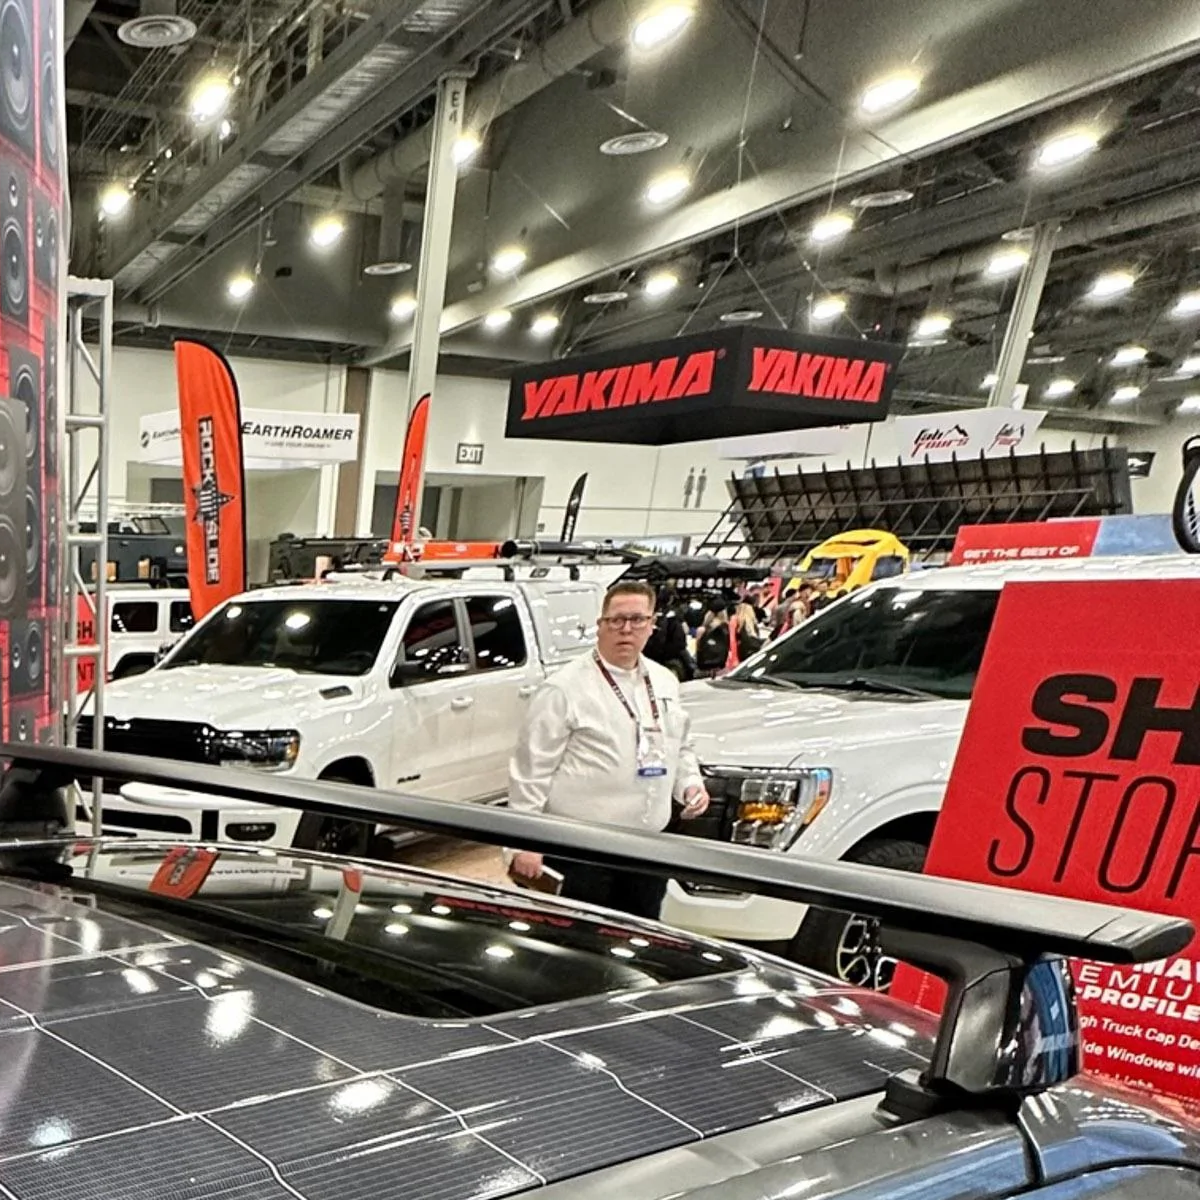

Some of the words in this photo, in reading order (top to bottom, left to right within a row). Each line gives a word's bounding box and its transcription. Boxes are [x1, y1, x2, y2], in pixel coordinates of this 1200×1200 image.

[521, 350, 716, 421] YAKIMA
[747, 347, 887, 403] YAKIMA
[1020, 547, 1055, 557] BEST
[1102, 1018, 1142, 1038] Truck
[1145, 1028, 1175, 1046] Cap
[1107, 1045, 1174, 1072] Windows
